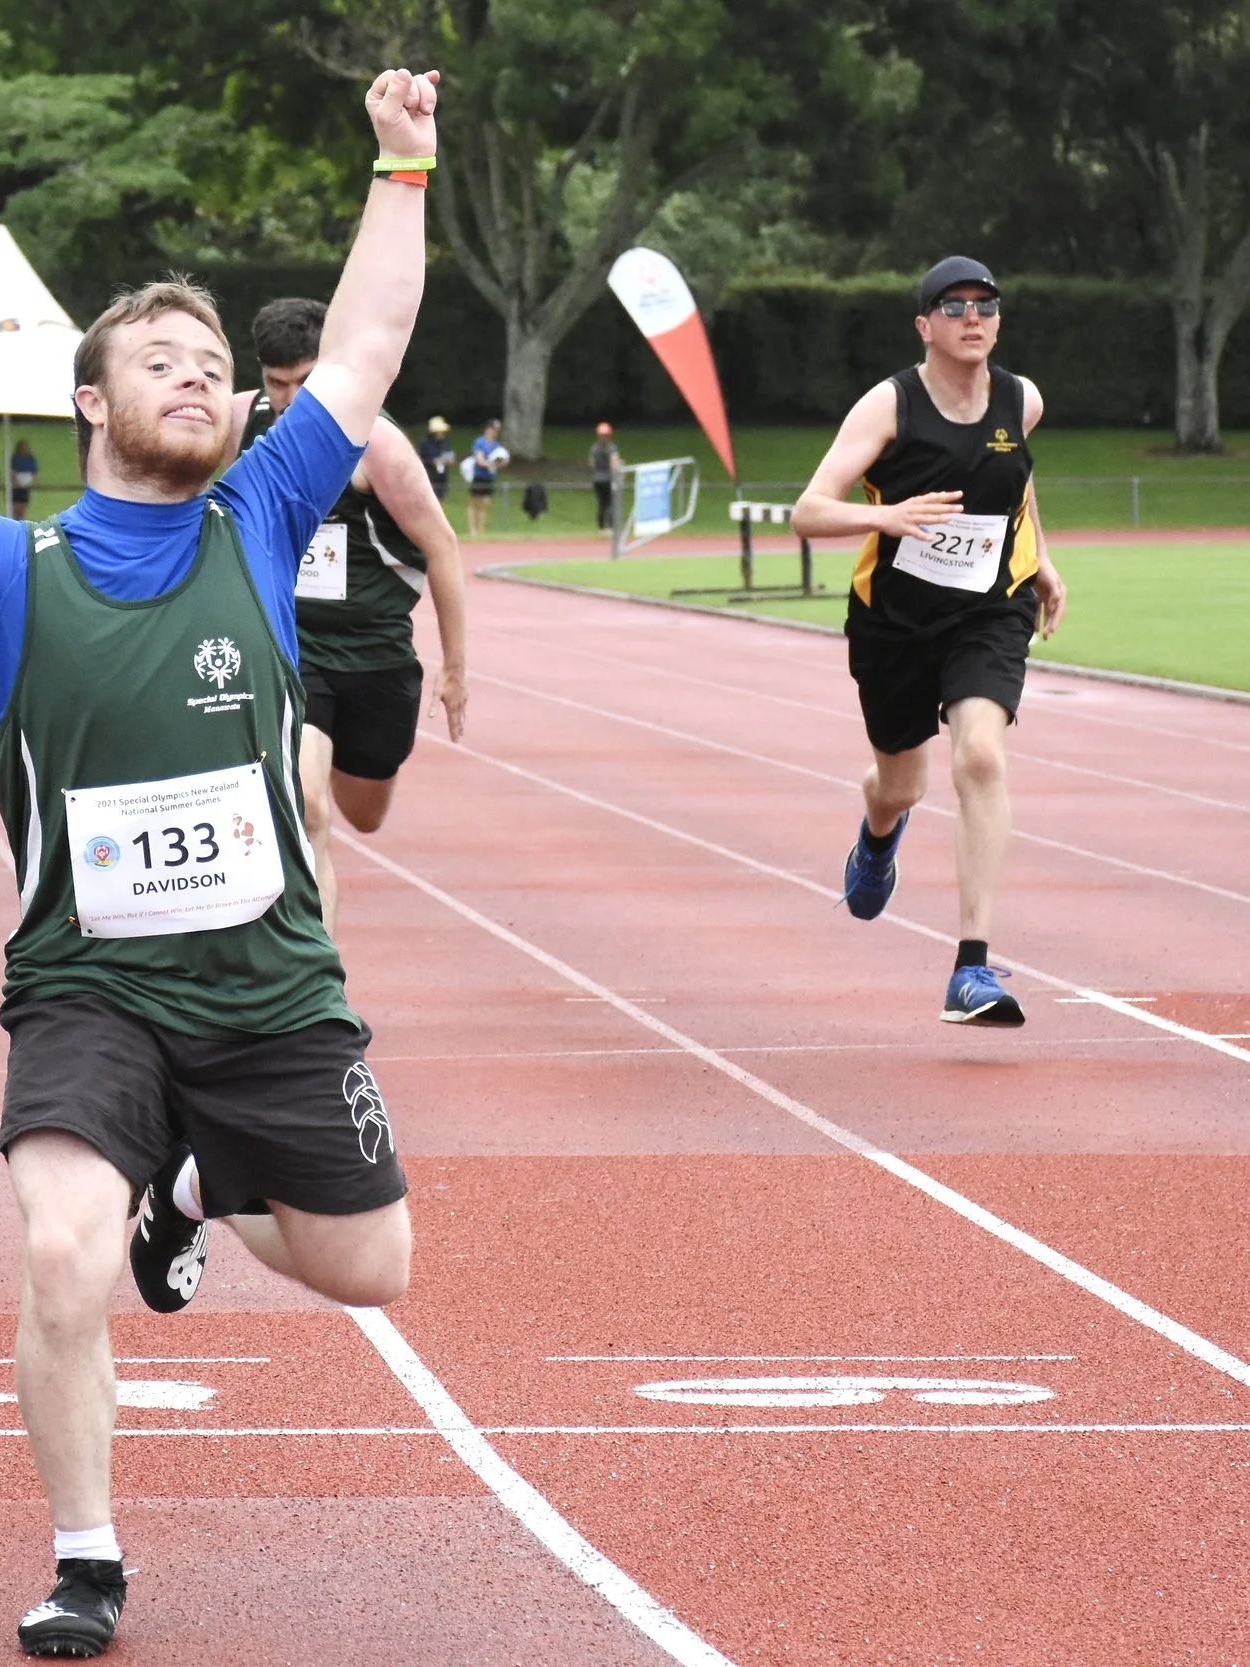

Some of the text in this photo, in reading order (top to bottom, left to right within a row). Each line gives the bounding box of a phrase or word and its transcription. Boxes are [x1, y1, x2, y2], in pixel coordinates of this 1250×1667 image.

[931, 532, 975, 556] 221
[920, 551, 975, 568] LIVINGSTONE
[96, 781, 240, 809] 2021 Special Olympics New Zealand
[121, 796, 221, 817] National Summer Games
[132, 822, 220, 870] 133
[133, 872, 226, 896] DAVIDSON
